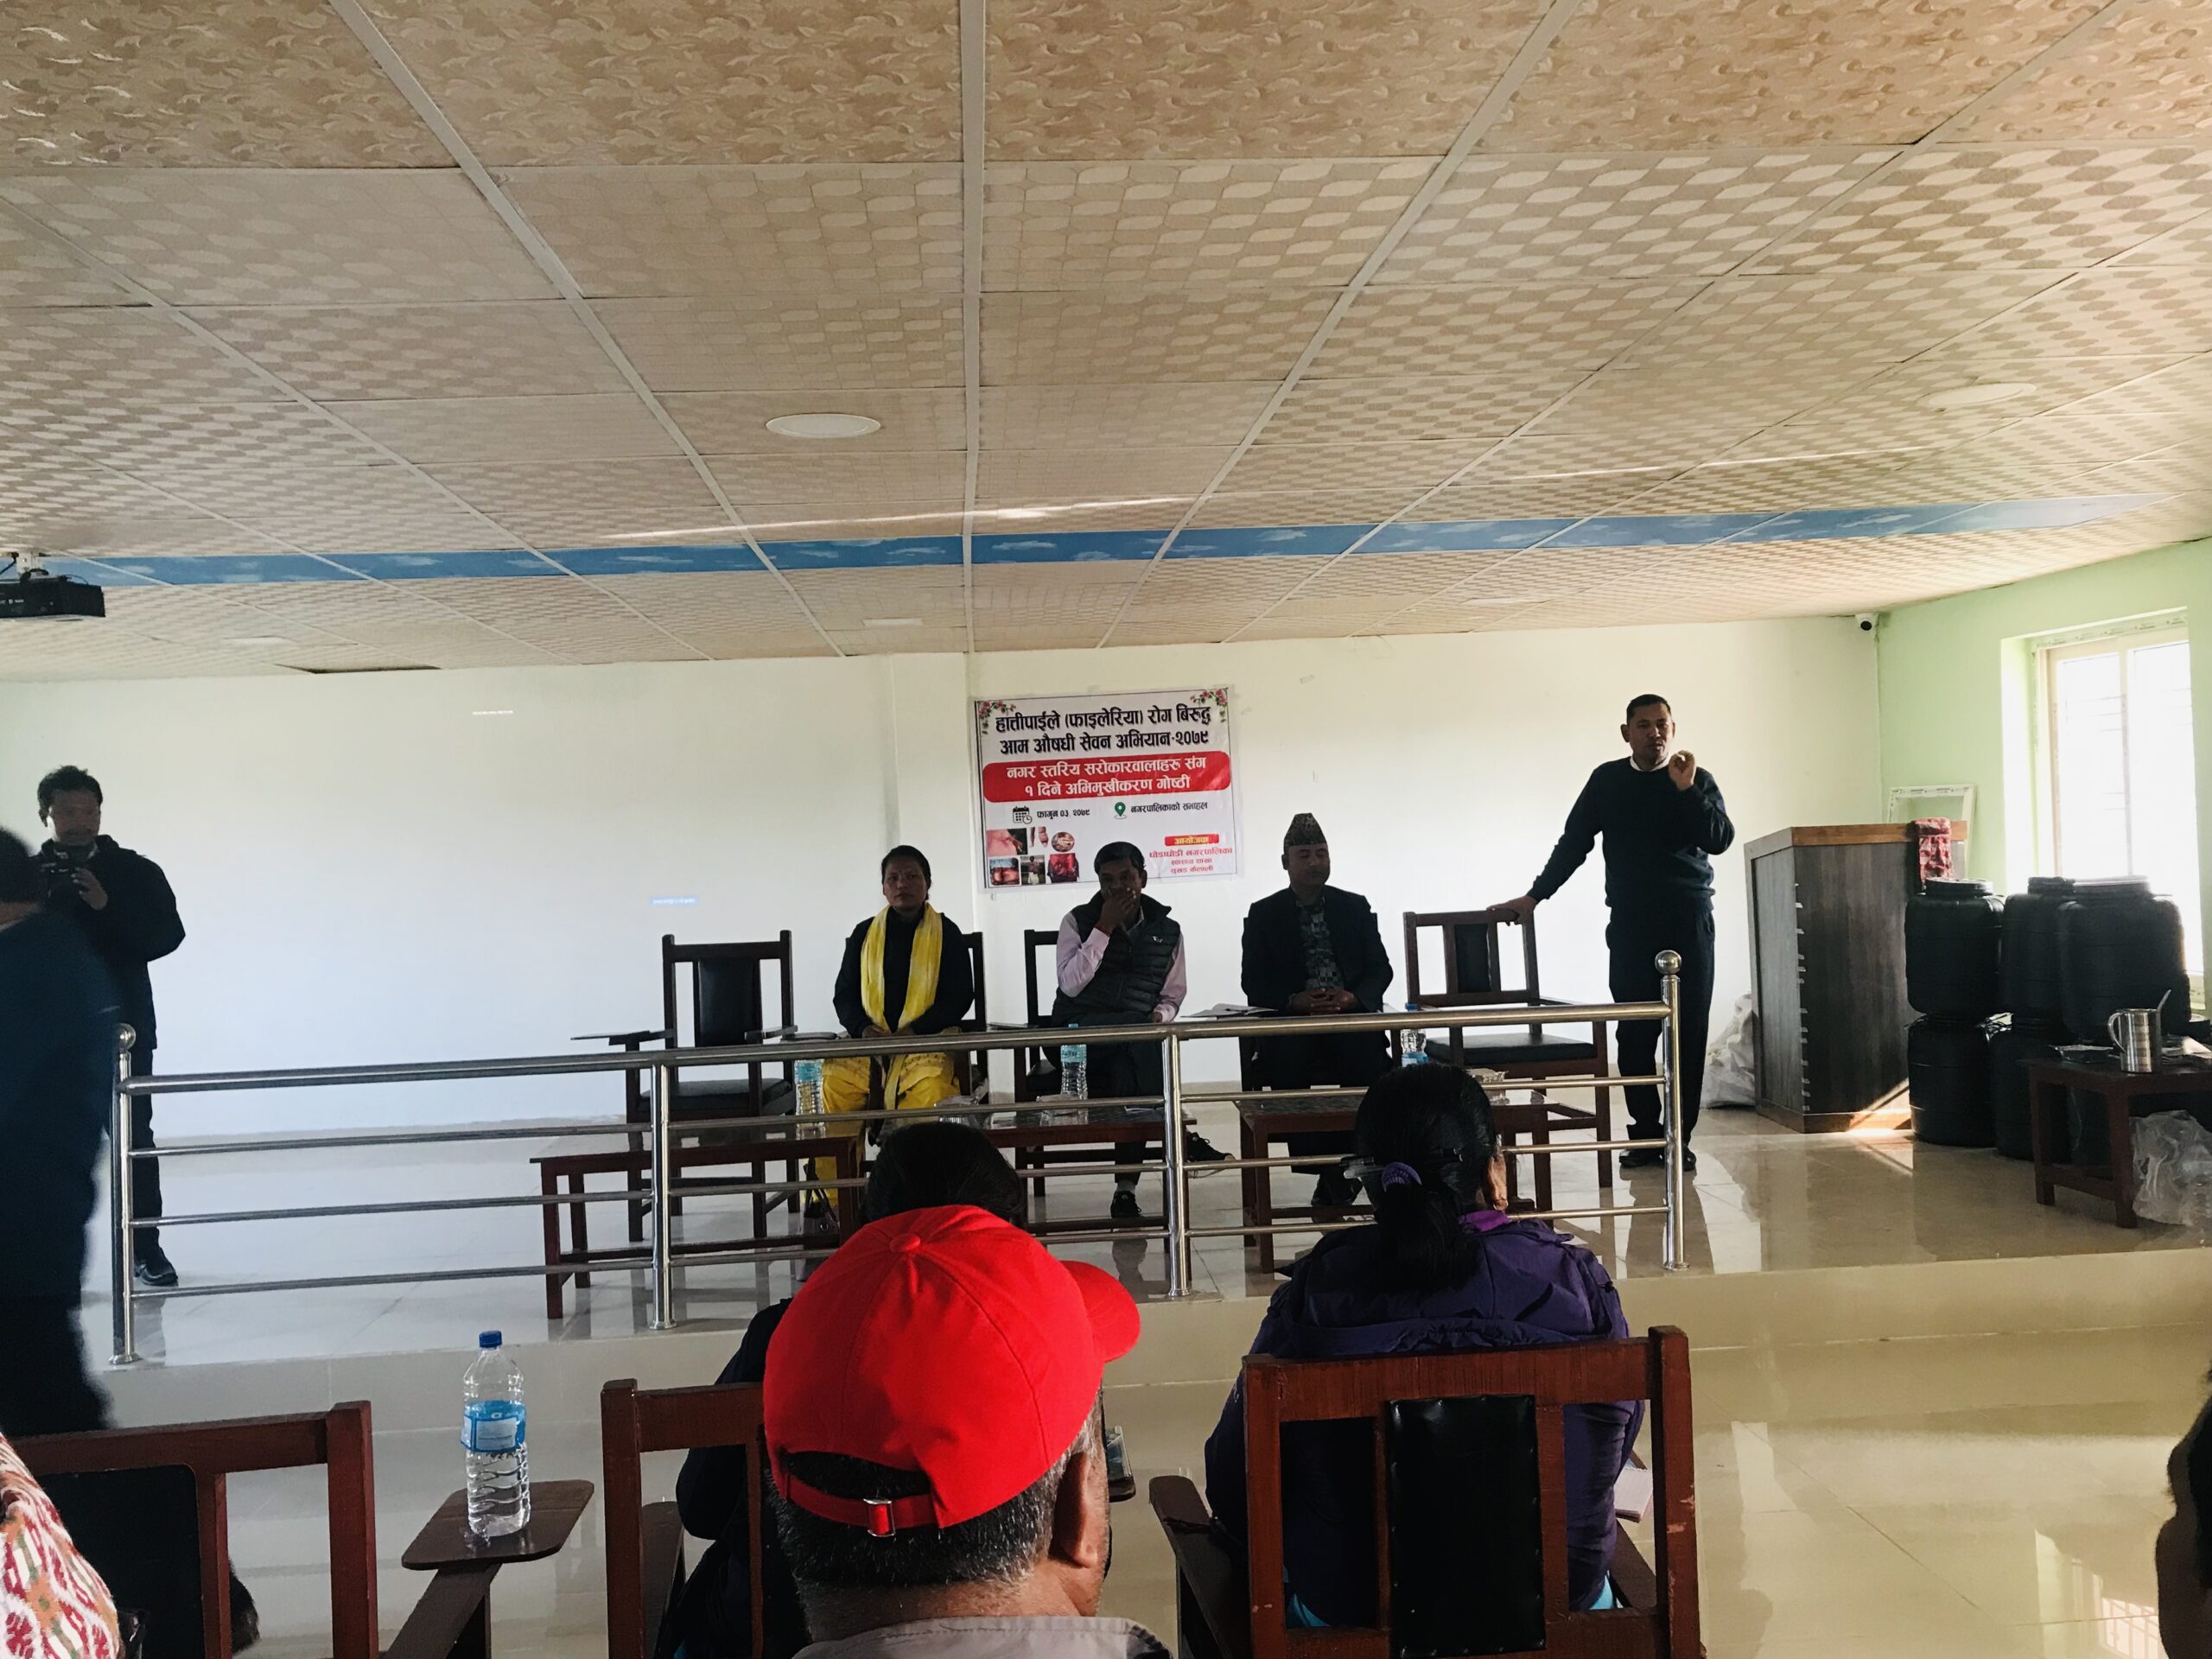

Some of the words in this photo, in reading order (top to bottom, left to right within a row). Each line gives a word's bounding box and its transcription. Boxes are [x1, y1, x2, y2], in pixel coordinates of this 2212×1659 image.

[1065, 707, 1143, 729] (फाइलेरिया)
[1147, 705, 1173, 724] रोग
[1000, 739, 1029, 755] आम
[1033, 733, 1075, 753] औषधी
[1079, 731, 1112, 752] सेवन
[1007, 766, 1036, 779] नगर
[1040, 761, 1080, 778] स्तरिय
[1185, 755, 1206, 769] संग
[1025, 785, 1033, 797] १
[1038, 780, 1061, 797] दिने
[1065, 778, 1153, 797] अभिमुखीकरण
[1156, 774, 1191, 790] गोष्ठी
[1130, 802, 1180, 814] नगरपालिकाको
